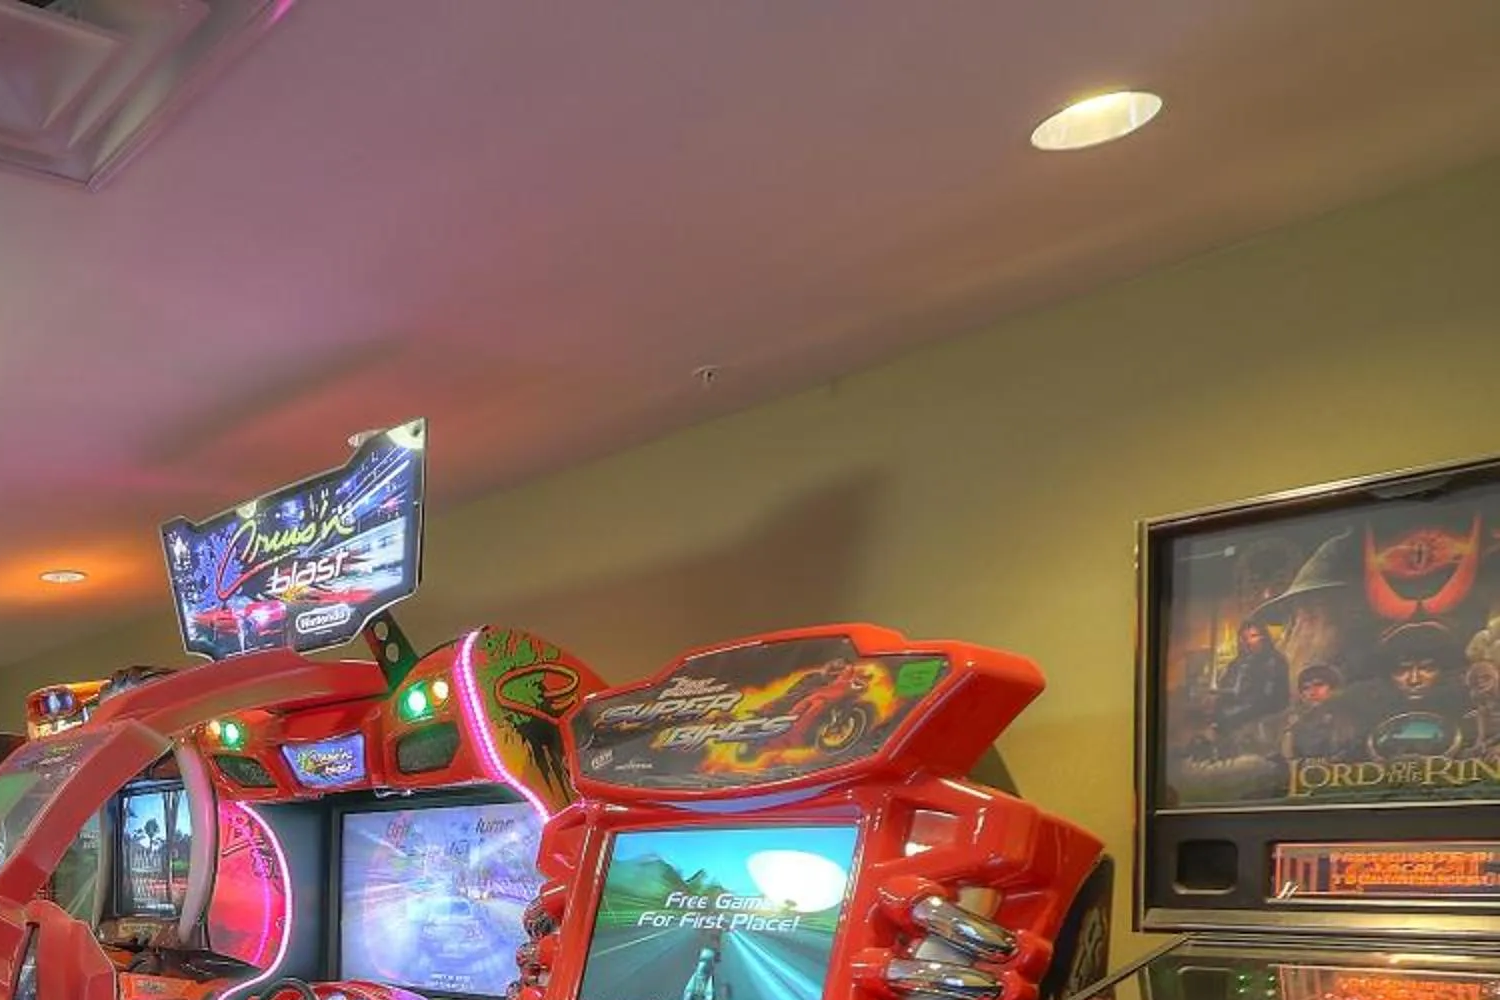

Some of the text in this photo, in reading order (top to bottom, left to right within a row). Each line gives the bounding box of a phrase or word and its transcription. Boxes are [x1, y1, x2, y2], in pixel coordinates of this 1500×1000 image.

[263, 548, 350, 595] blast
[300, 607, 346, 630] Nintendo
[600, 692, 743, 723] SUPER
[664, 715, 799, 752] BIKES
[1287, 759, 1385, 797] LORD
[665, 891, 709, 909] Free
[637, 911, 800, 932] For First Place!
